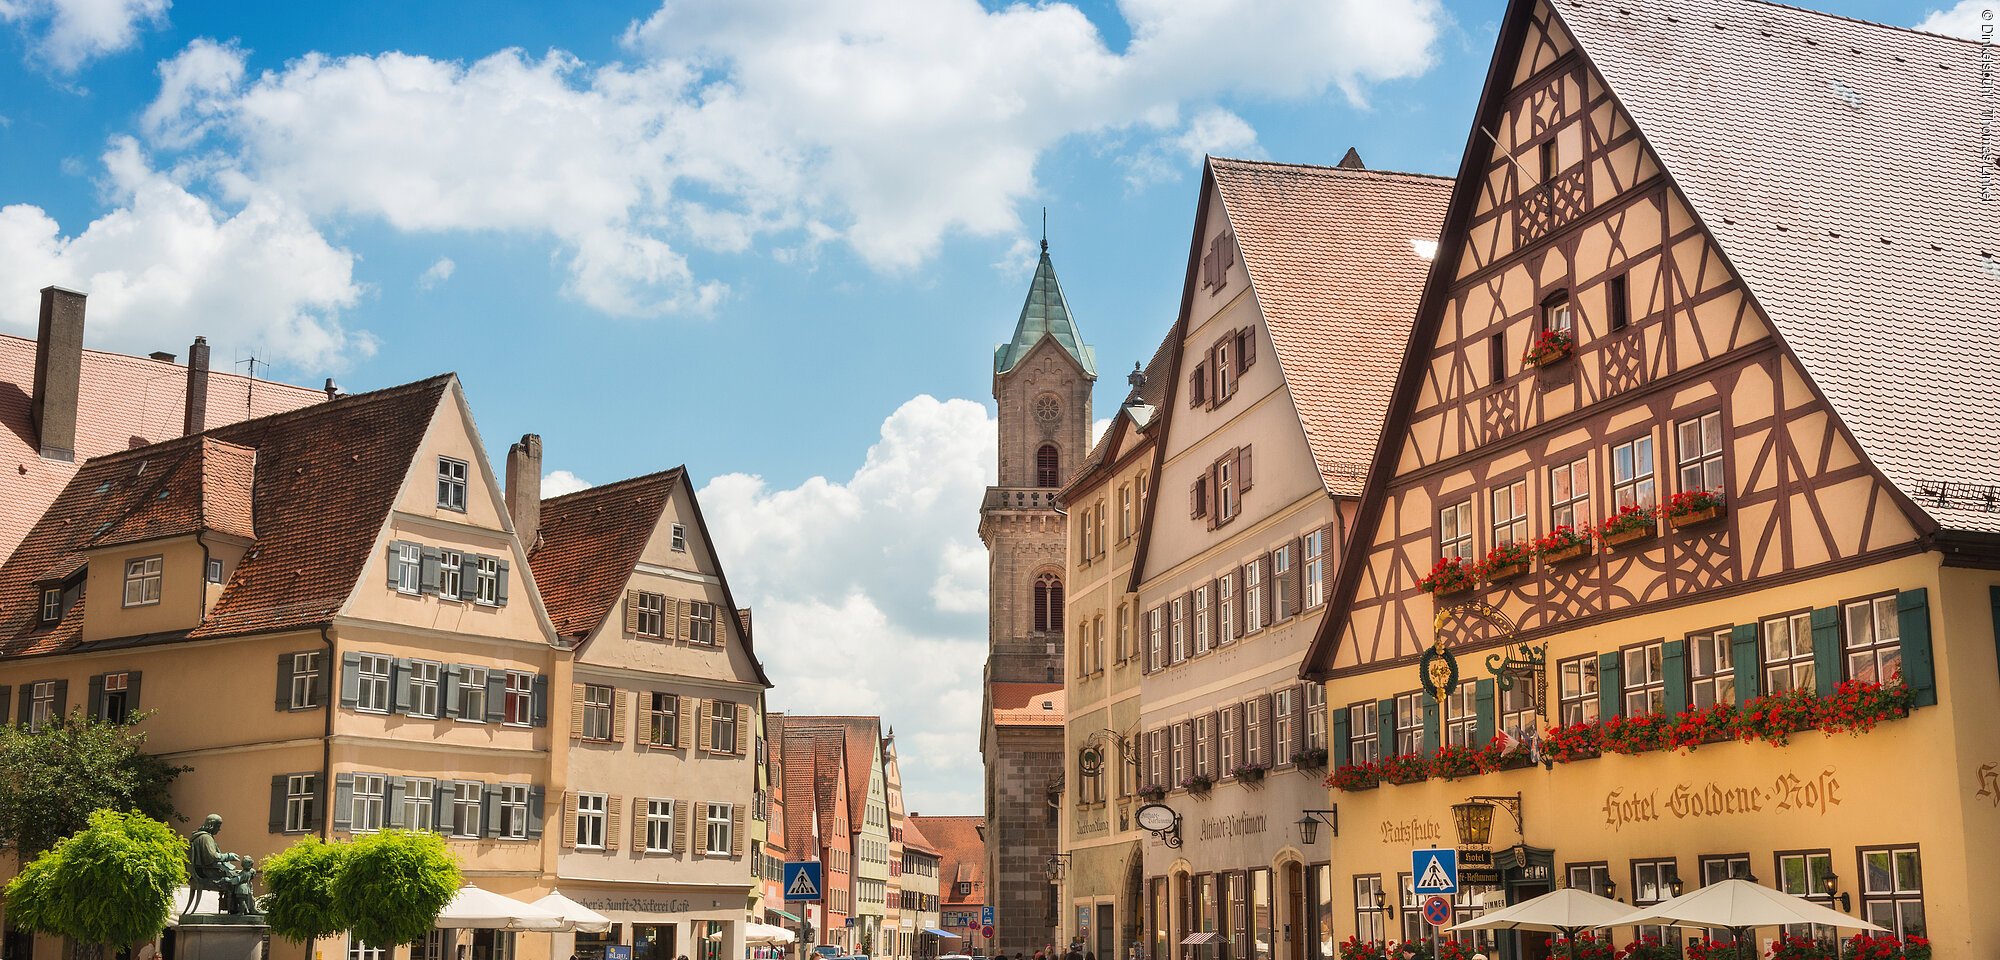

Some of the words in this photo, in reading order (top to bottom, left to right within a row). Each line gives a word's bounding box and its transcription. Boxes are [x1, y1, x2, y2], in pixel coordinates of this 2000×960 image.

[1602, 786, 1659, 832] Hotel
[1465, 852, 1485, 862] Hotel
[1484, 899, 1505, 910] ZIMMER
